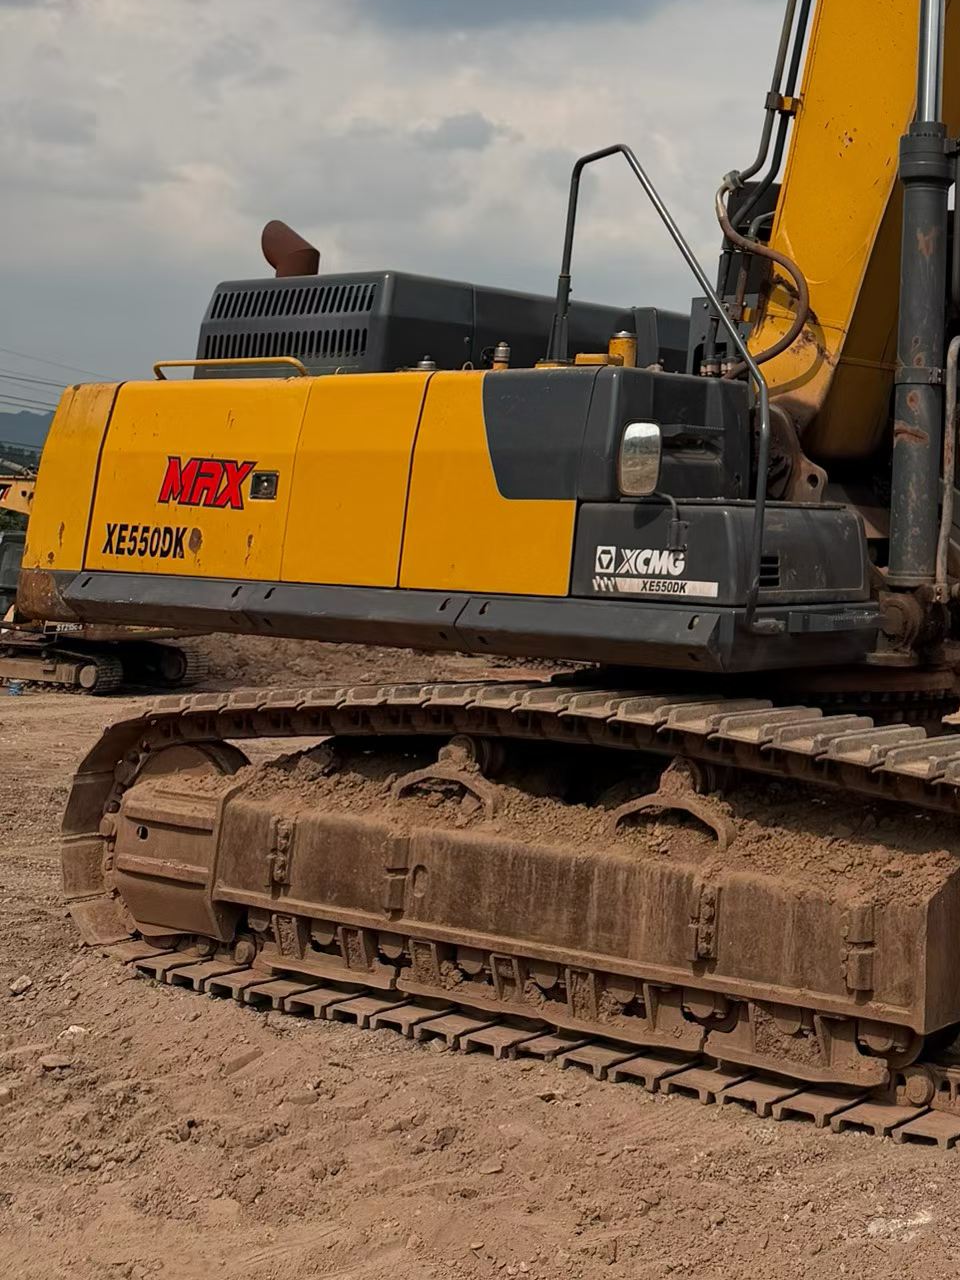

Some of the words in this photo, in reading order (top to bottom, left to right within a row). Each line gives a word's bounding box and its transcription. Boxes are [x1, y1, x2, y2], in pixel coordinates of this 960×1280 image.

[158, 456, 258, 510] MAX
[102, 523, 188, 559] XE550DK
[616, 548, 685, 576] XCMG
[640, 579, 688, 594] XE550DK
